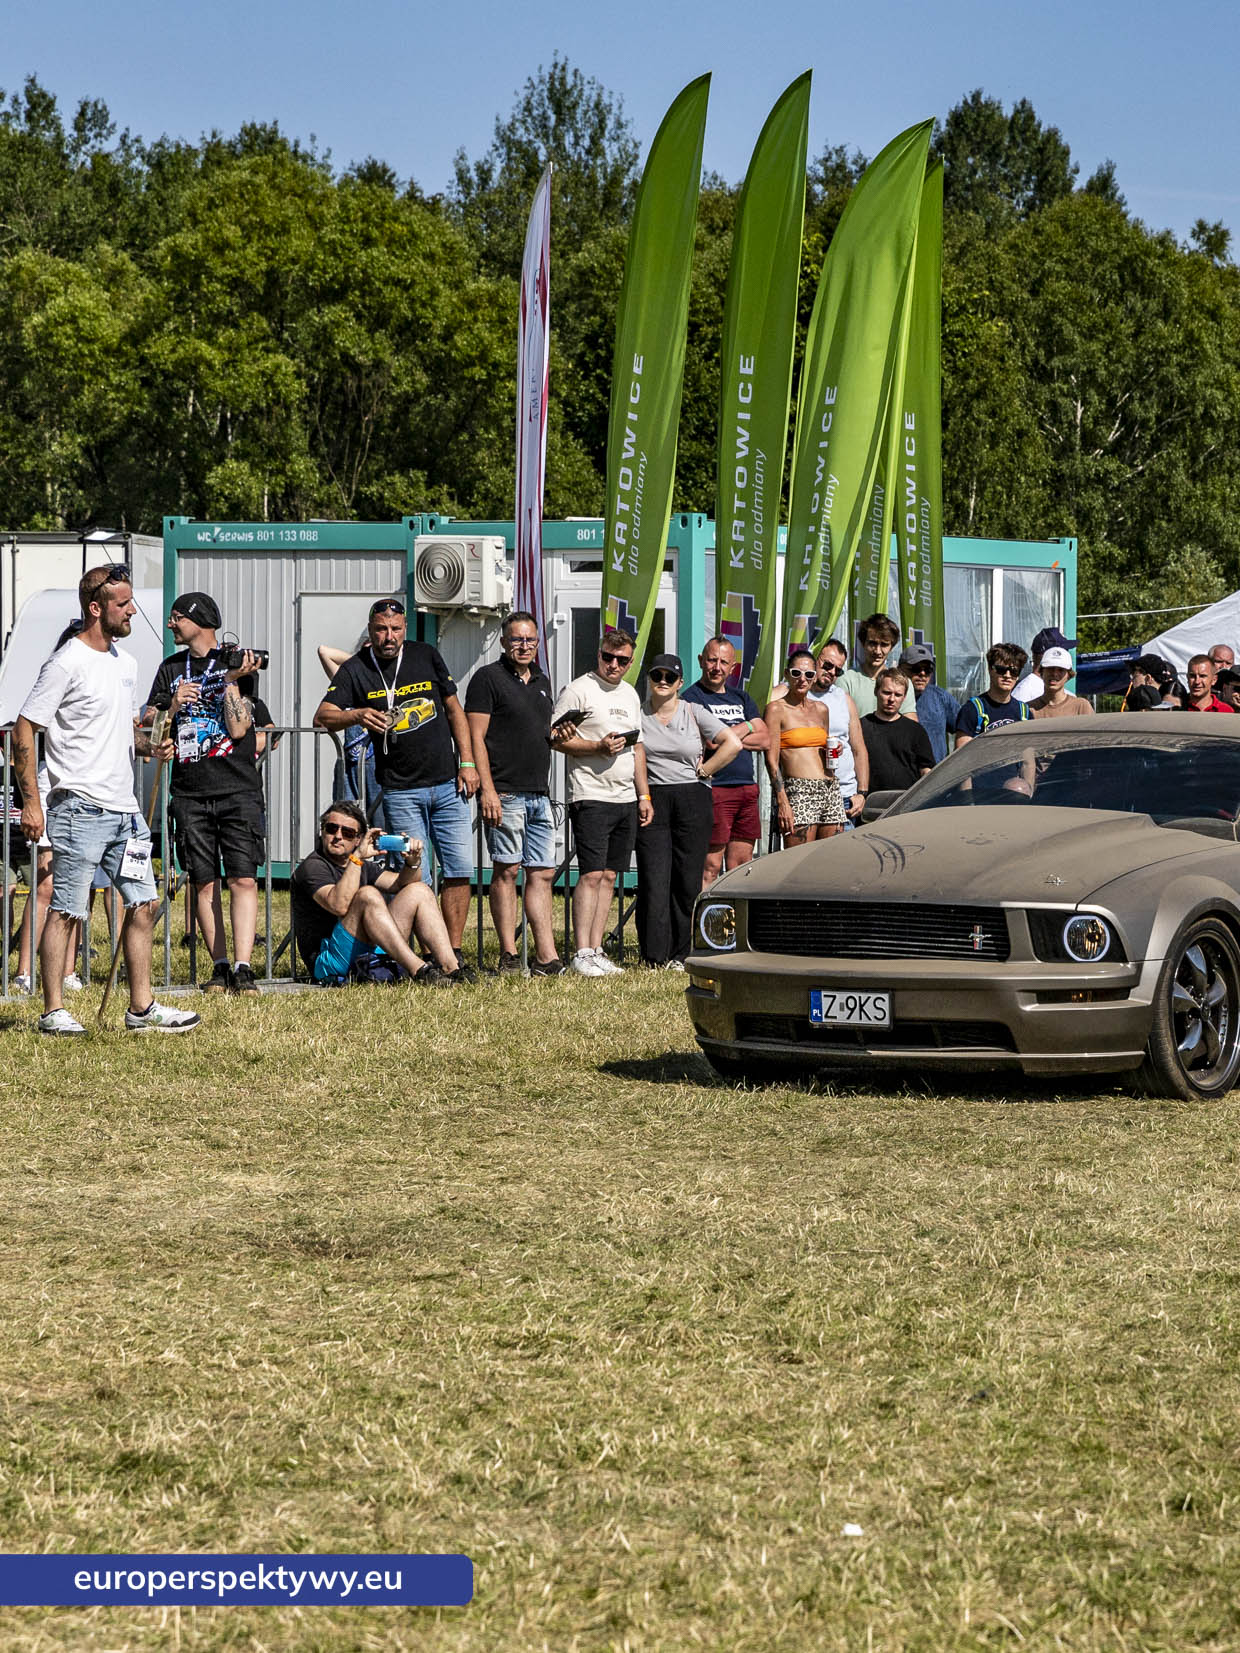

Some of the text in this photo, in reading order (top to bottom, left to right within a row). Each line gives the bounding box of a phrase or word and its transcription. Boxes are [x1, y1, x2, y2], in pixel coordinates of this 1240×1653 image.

[612, 352, 644, 574] KATOWICE
[627, 450, 648, 577] dla odmiany
[729, 354, 755, 569] KATOWICE
[750, 448, 767, 571] dla odmiany
[818, 473, 840, 554] odmiany
[904, 411, 918, 606] KATOWICE
[256, 530, 275, 542] 801
[279, 530, 297, 542] 133
[299, 530, 319, 542] 088
[576, 528, 597, 541] 801
[919, 496, 932, 607] dla odmiany
[812, 1008, 822, 1017] PL
